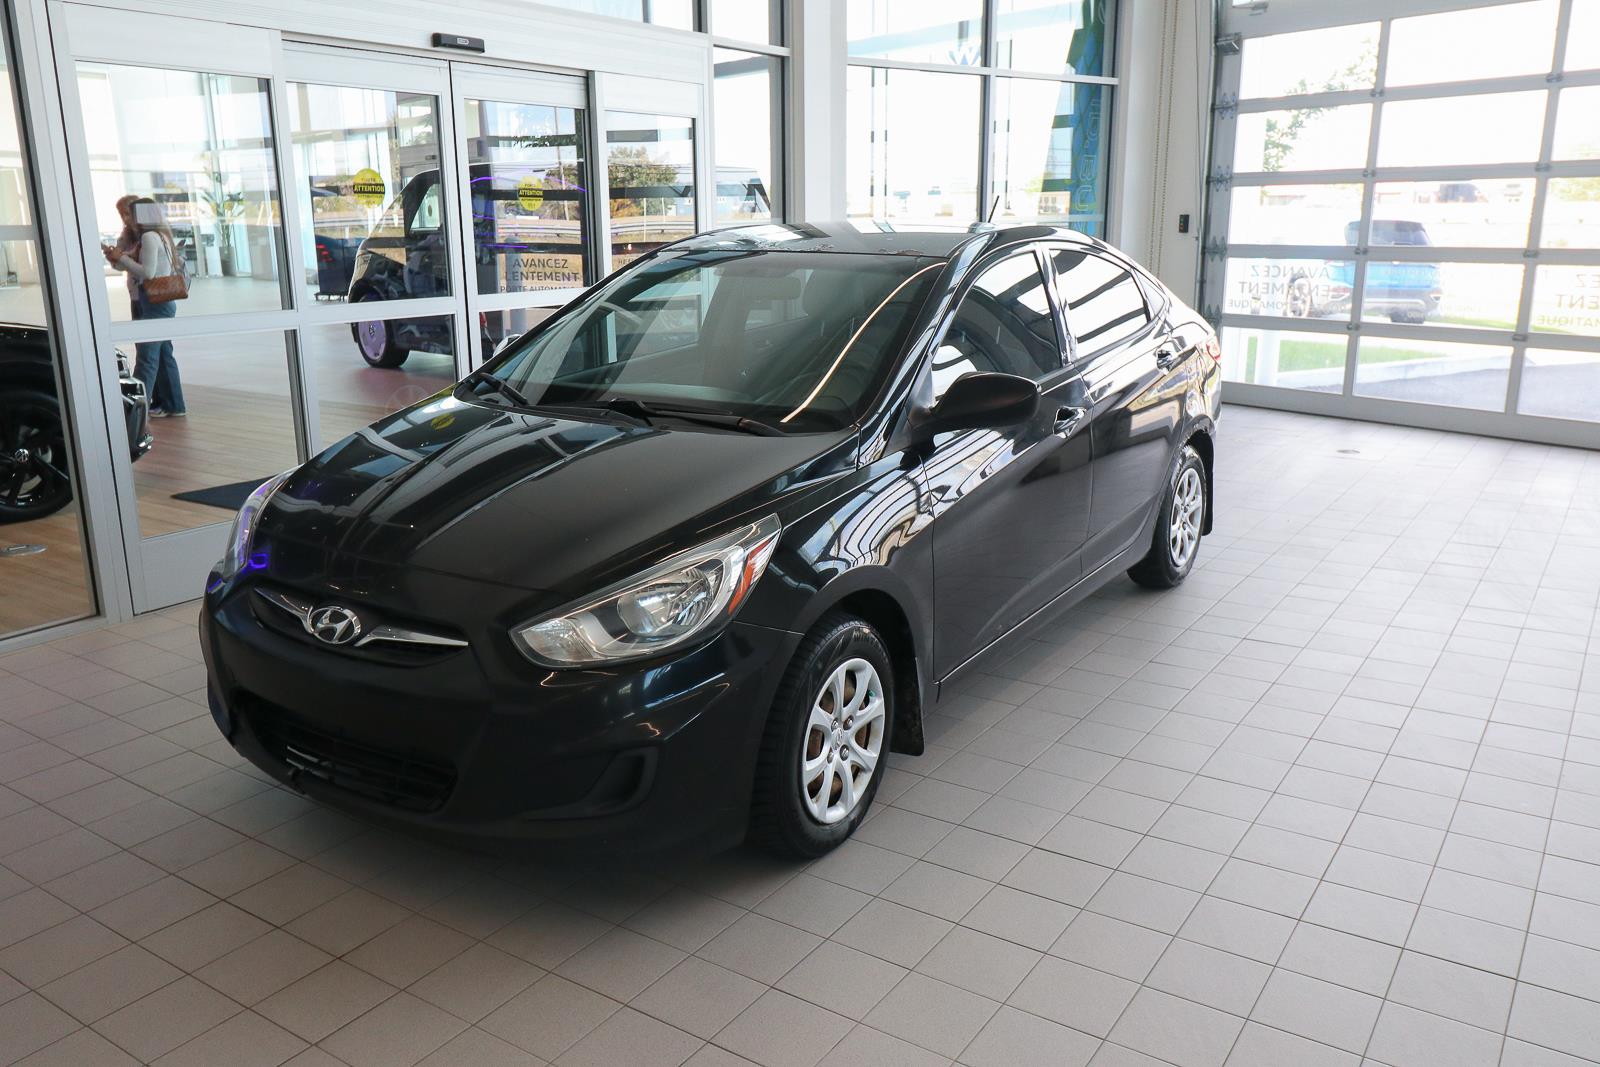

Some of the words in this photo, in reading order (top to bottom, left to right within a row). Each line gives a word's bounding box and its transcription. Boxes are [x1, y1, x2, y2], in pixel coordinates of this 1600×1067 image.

[353, 184, 385, 192] ATTENTION
[512, 258, 569, 269] AVANCEZ
[505, 271, 579, 282] LENTEMENT
